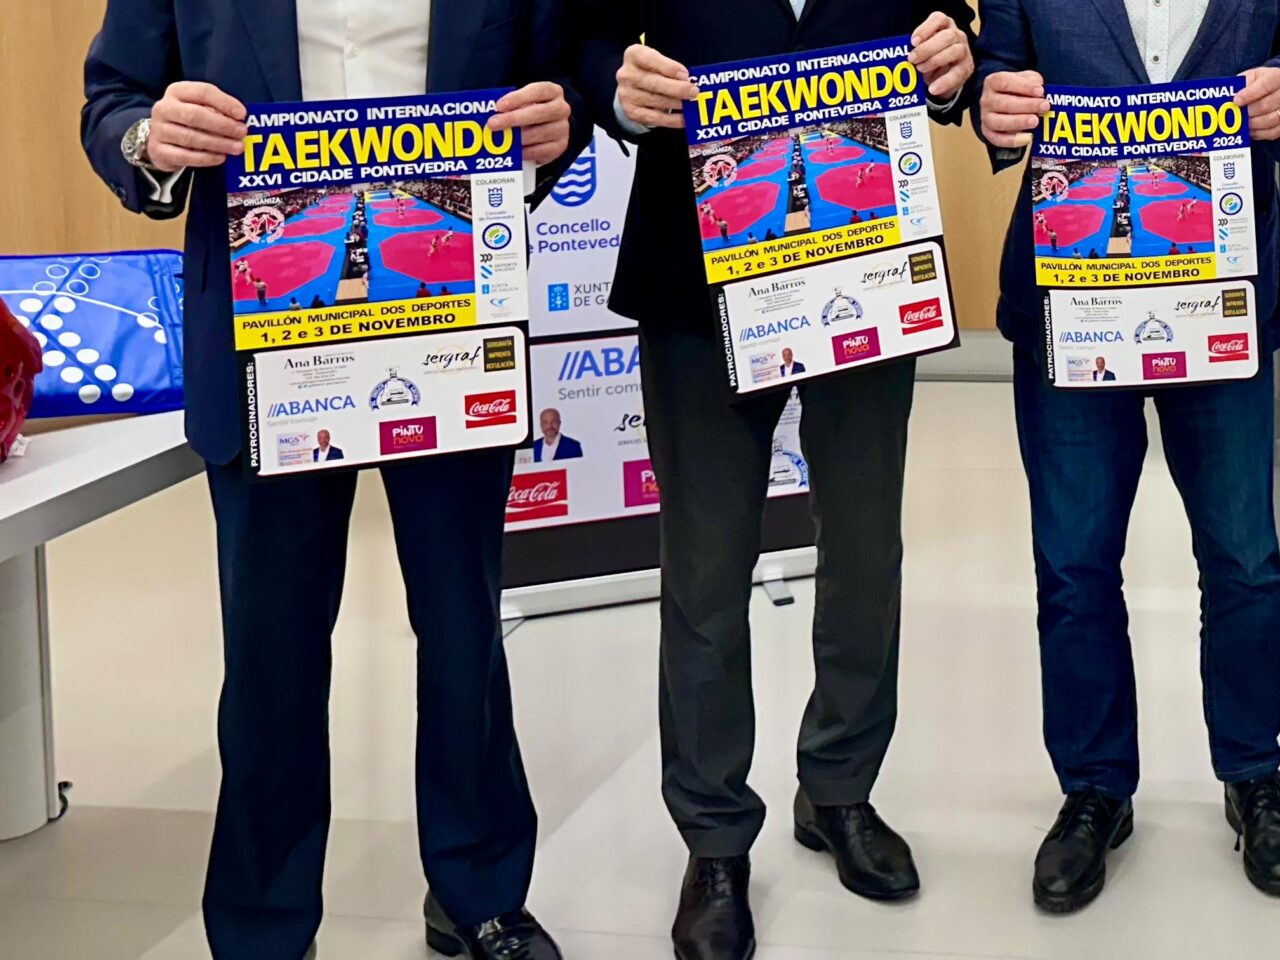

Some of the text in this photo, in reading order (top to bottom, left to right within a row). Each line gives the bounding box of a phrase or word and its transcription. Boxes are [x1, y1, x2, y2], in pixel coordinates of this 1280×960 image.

[796, 44, 912, 72] INTERNACIONAL
[694, 60, 917, 126] TAEKWONDO
[1044, 86, 1237, 108] AMPIONATO INTERNACIONAL
[245, 100, 498, 128] AMPIONATO INTERNACIONA
[697, 94, 919, 140] XXVI CIDADE PONTEVEDRA 2024
[1040, 102, 1242, 145] TAEKWONDO
[240, 117, 512, 173] TAEKWONDO
[1039, 135, 1243, 157] XXVI CIDADE PONTEVEDRA 2024
[238, 156, 513, 188] XXVI CIDADE PONTEVEDRA 2024
[536, 219, 611, 235] Concello
[538, 234, 620, 253] Ponteved
[711, 220, 896, 266] PAVILLÓN MUNICIPAL DOS DEPORTES
[783, 235, 884, 264] DE NOVEMBRO
[1040, 256, 1212, 271] PAVILLÓN MUNICIPAL DOS DEPORTES
[1103, 269, 1200, 282] DE NOVEMBRO
[575, 282, 611, 294] XUNT
[748, 278, 806, 298] Ana Barros
[574, 296, 590, 307] DE
[1070, 297, 1123, 307] Ana Barros
[242, 299, 471, 331] PAVILLÓN MUNICIPAL DOS DEPORTES
[282, 330, 292, 341] 2
[297, 329, 307, 339] e
[314, 327, 324, 337] 3
[330, 322, 353, 336] DE
[359, 313, 457, 333] NOVEMBRO
[283, 353, 356, 370] Ana Barros
[422, 345, 482, 370] sergraf
[558, 386, 602, 400] Sentir
[250, 362, 260, 467] PATROCINADORES:
